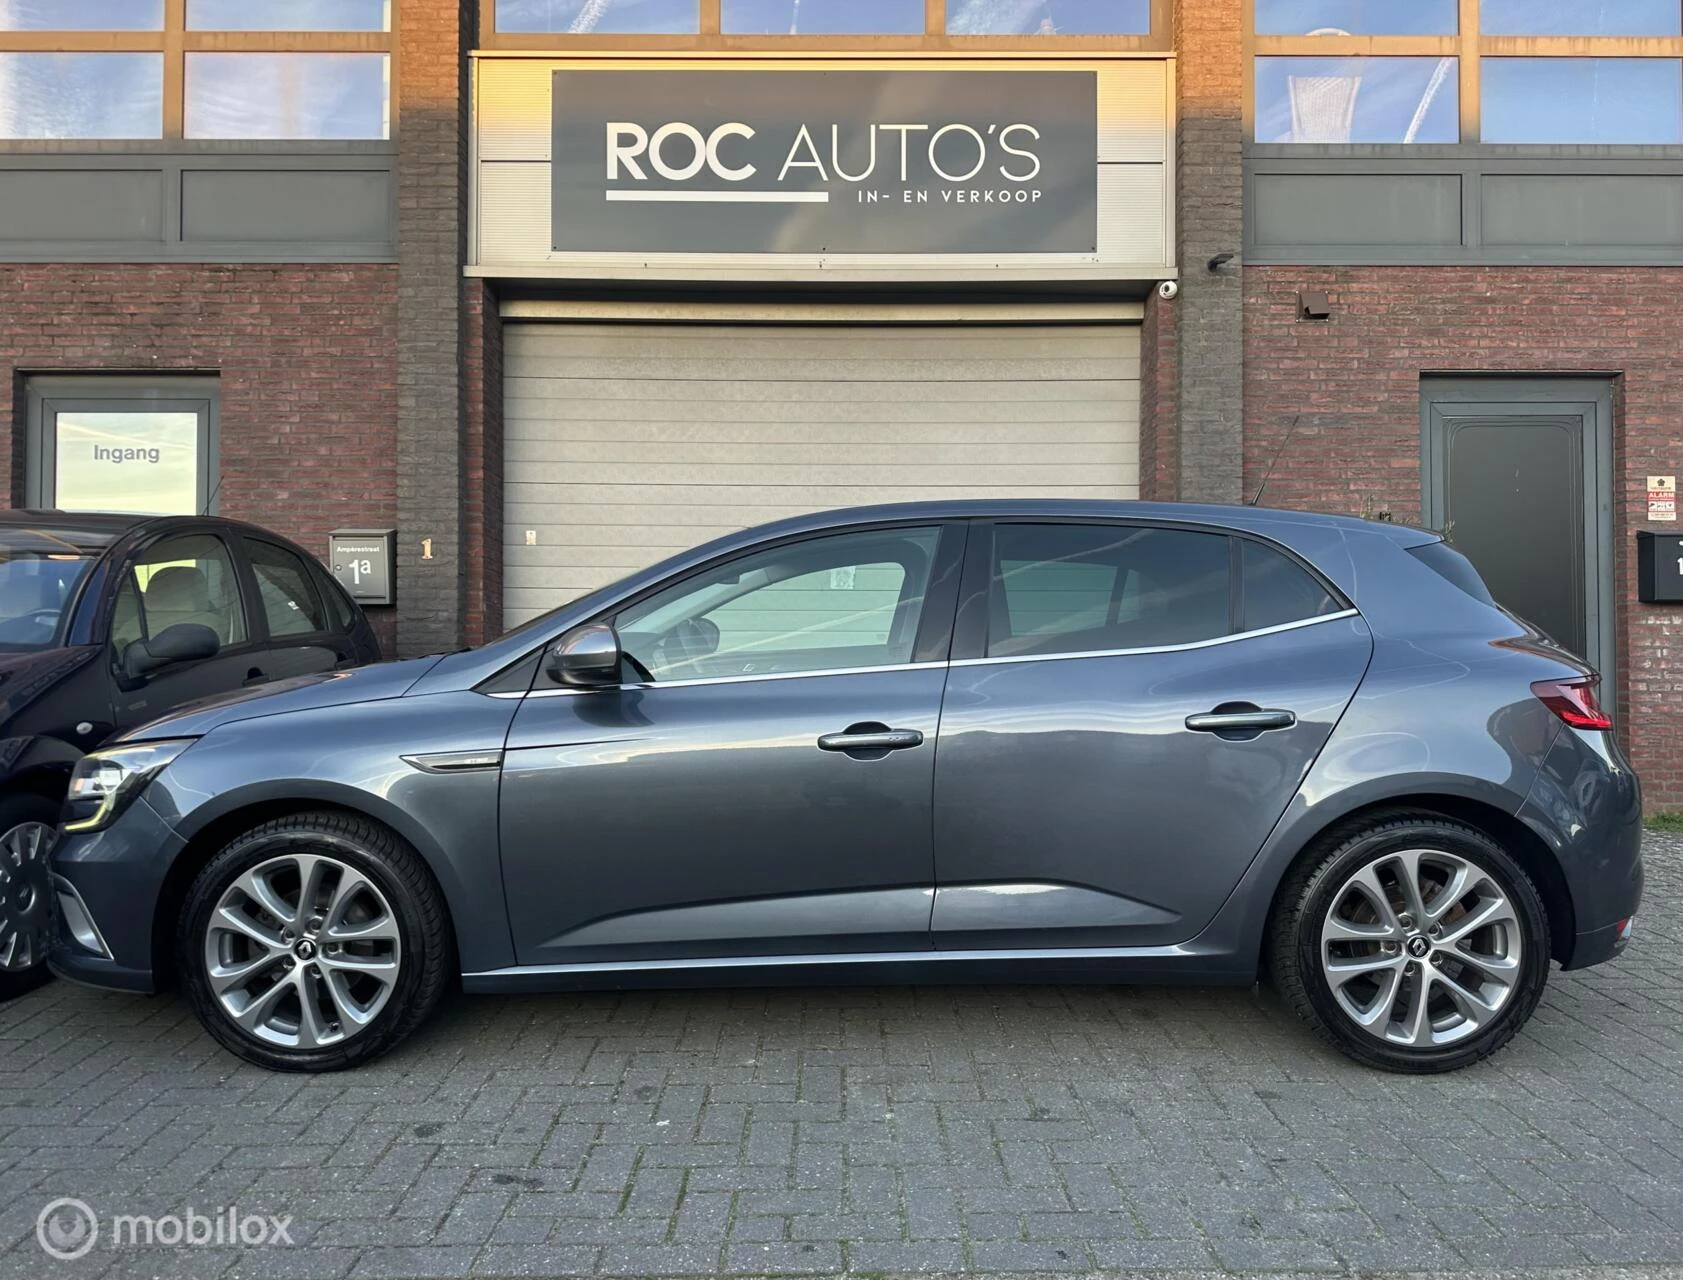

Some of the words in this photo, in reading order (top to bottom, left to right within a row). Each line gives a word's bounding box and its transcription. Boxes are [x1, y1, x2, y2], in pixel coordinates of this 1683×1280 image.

[606, 122, 757, 181] ROC
[778, 123, 1041, 182] AUTO'S
[858, 190, 891, 203] IN-
[903, 190, 928, 203] EN
[941, 190, 1042, 203] VERKOOP
[94, 444, 160, 464] Ingang
[420, 538, 433, 560] 1
[348, 559, 372, 585] 1a
